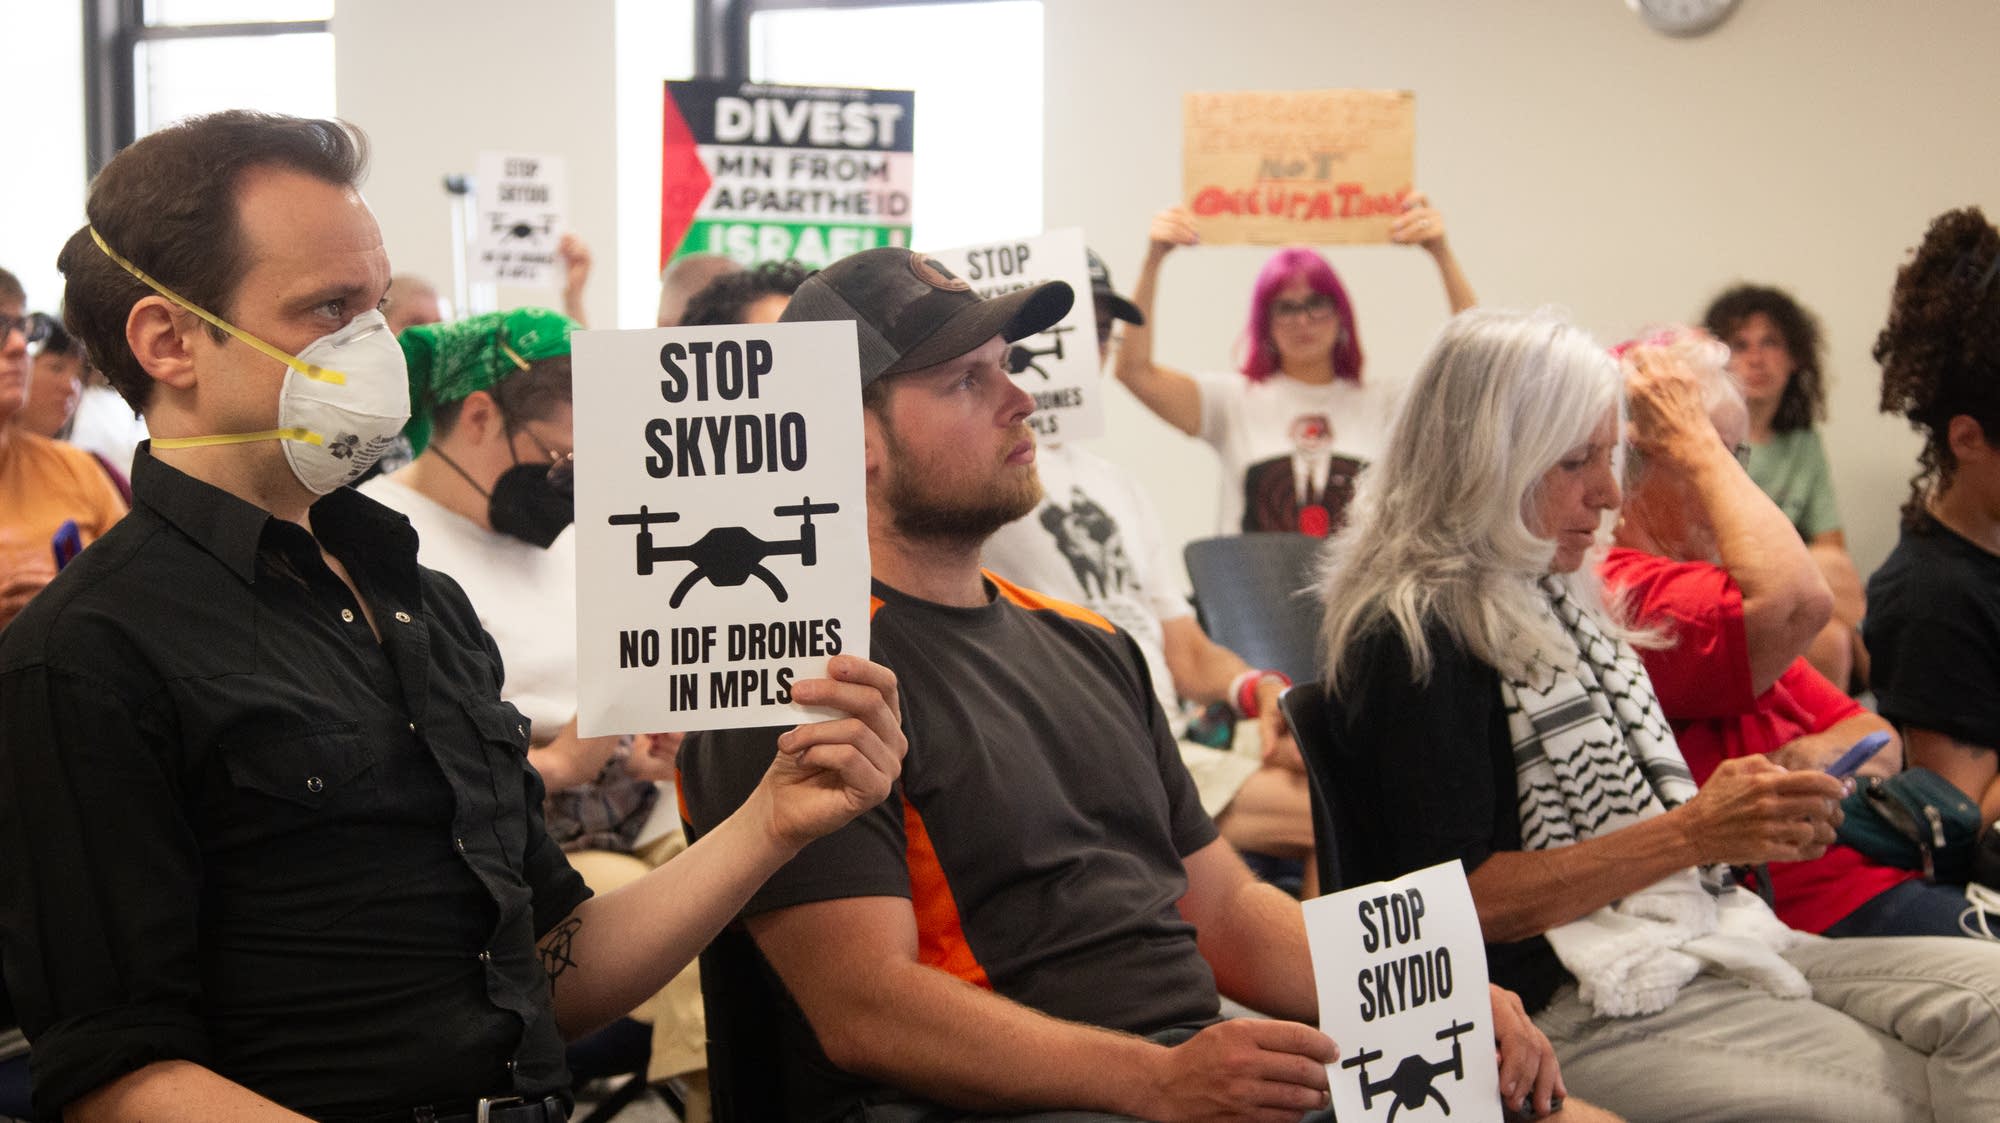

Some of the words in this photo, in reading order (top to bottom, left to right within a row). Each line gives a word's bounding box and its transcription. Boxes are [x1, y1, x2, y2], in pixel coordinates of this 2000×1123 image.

[714, 96, 904, 147] DIVEST
[717, 154, 773, 179] MN
[789, 155, 890, 182] FROM
[713, 187, 911, 216] APARTHEID
[967, 244, 1030, 281] STOP
[660, 339, 773, 403] STOP
[645, 412, 808, 479] SKYDIO
[619, 629, 660, 668] NO
[671, 626, 717, 666] IDF
[728, 618, 842, 662] DRONES
[669, 673, 698, 712] IN
[710, 667, 794, 709] MPLS
[1358, 888, 1425, 953] STOP
[1358, 947, 1453, 1022] SKYDIO
